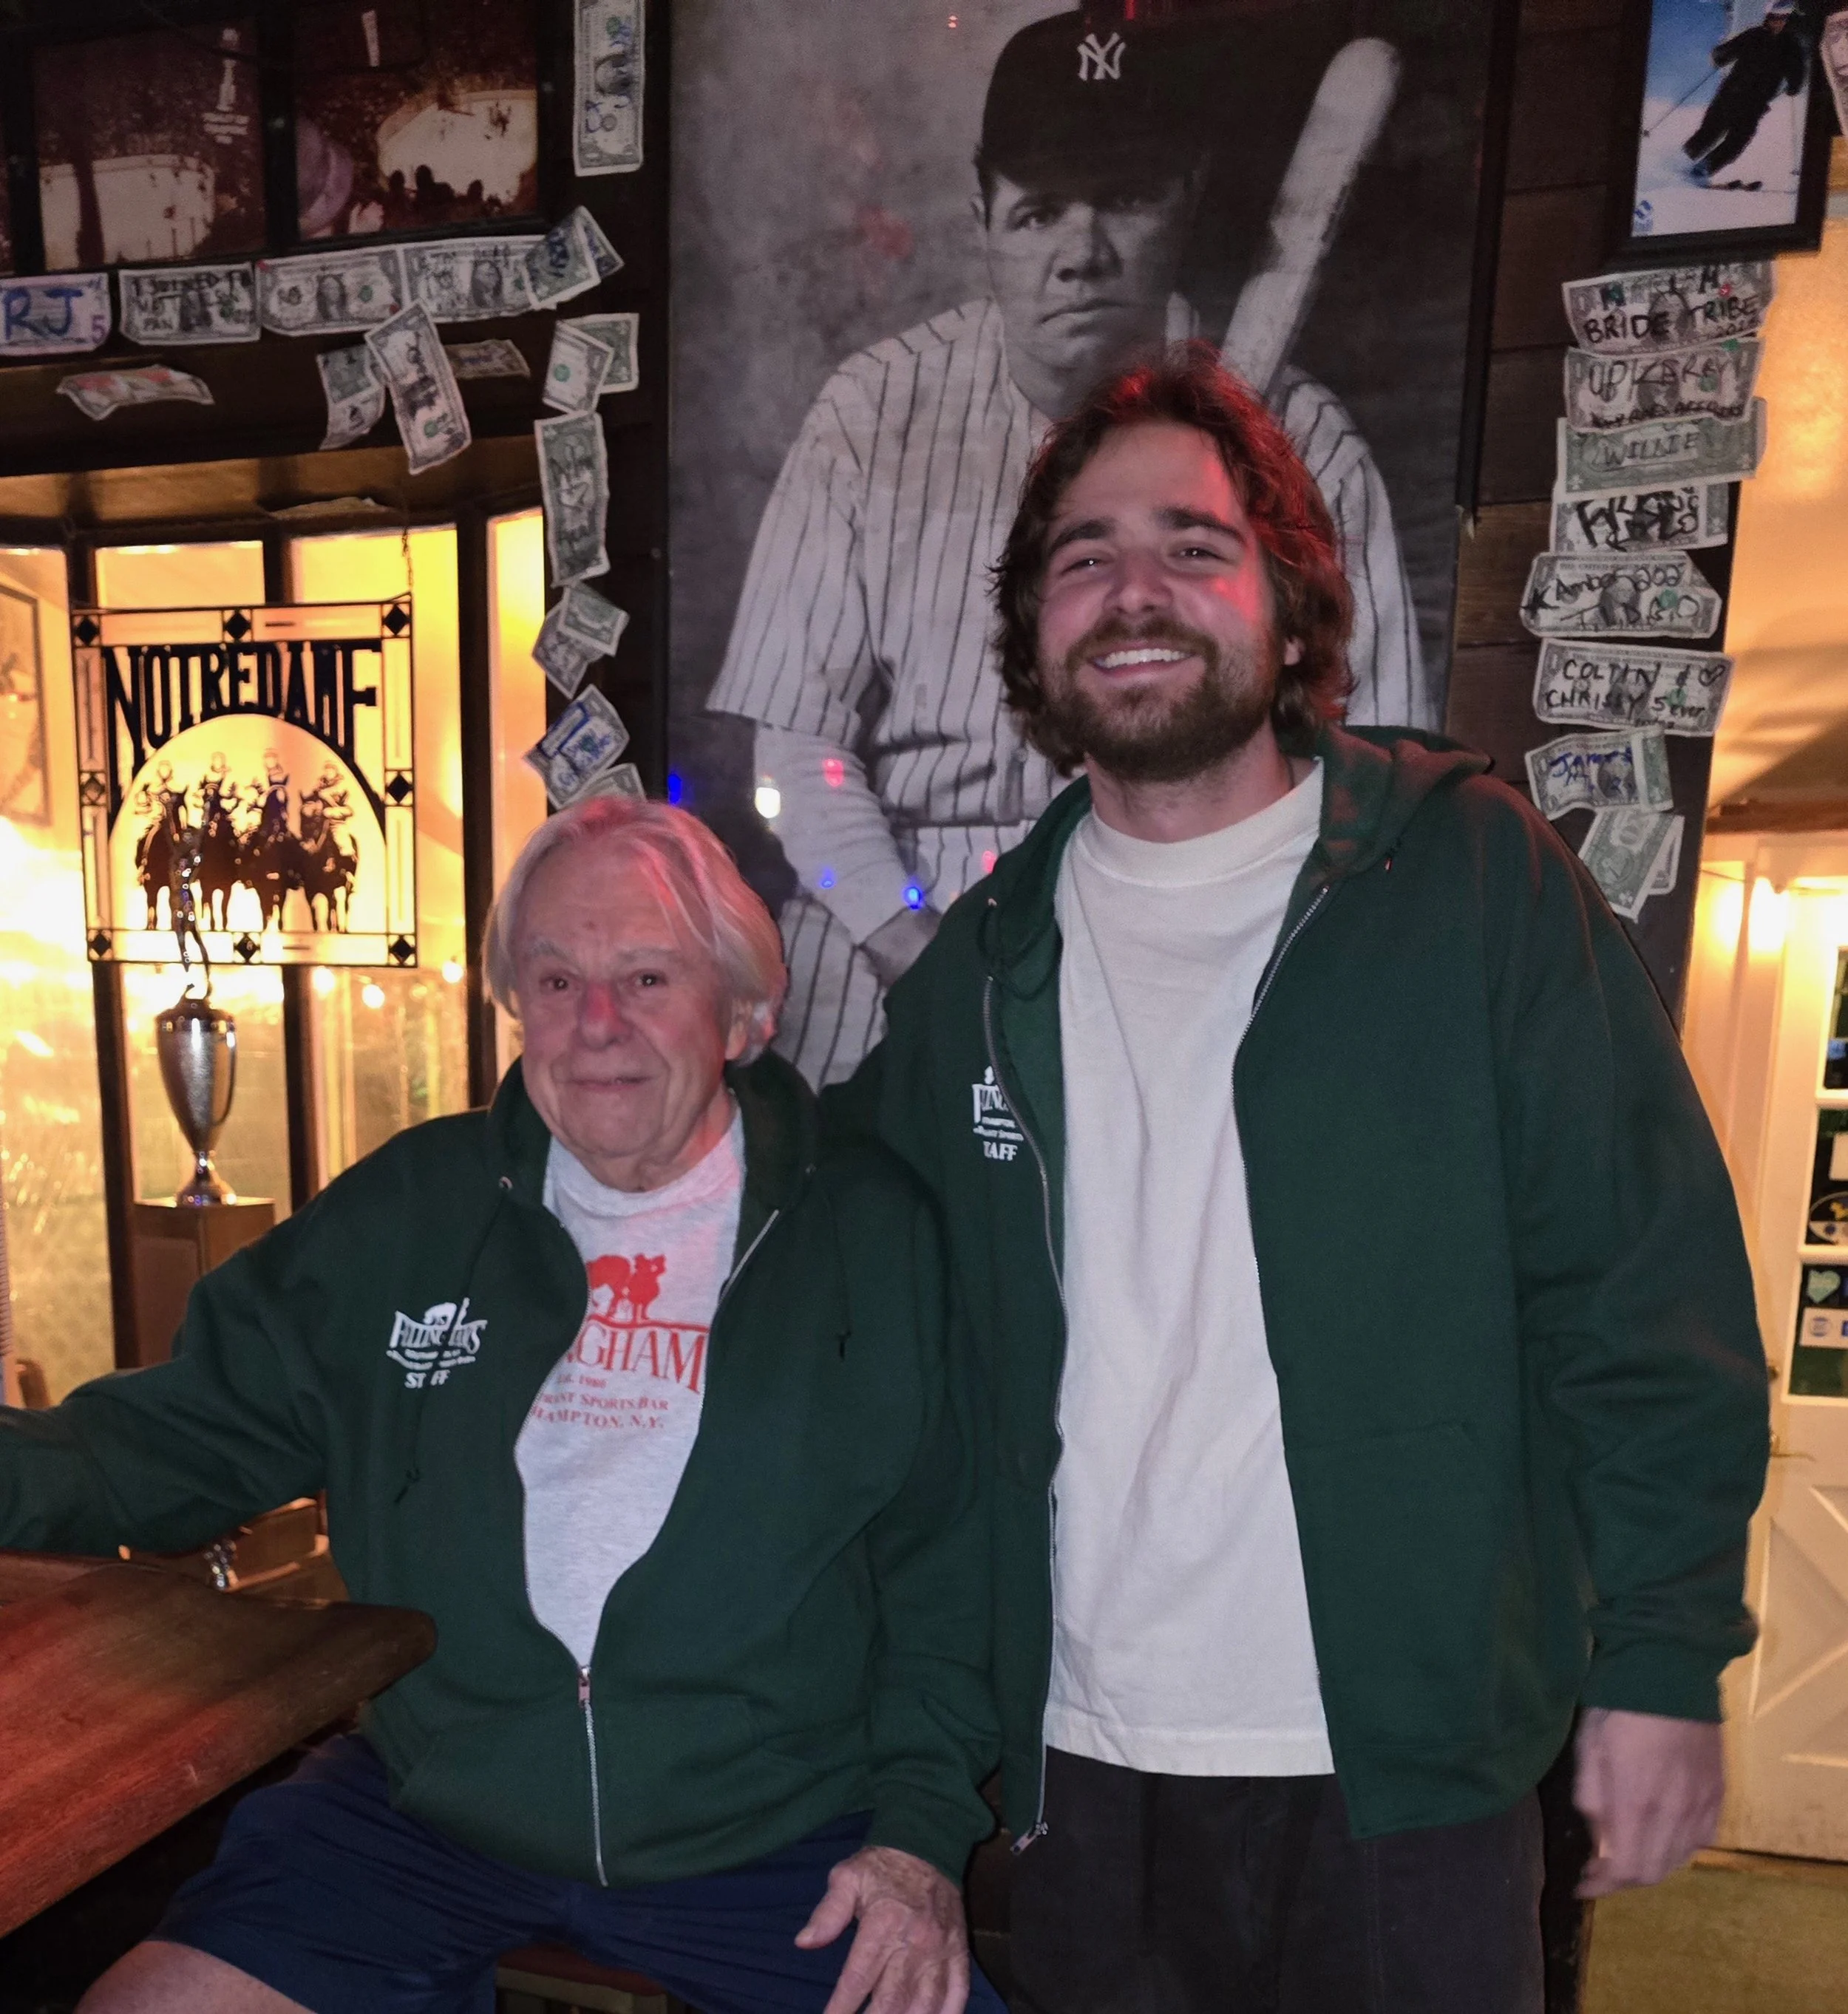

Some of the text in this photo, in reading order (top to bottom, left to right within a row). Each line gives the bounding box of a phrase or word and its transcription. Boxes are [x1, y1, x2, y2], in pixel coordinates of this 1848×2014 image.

[1076, 32, 1127, 81] NY
[3, 286, 83, 340] RJ
[1583, 310, 1671, 344] BRIDE
[103, 642, 257, 822] NOTRE
[566, 1322, 707, 1394] GHAM
